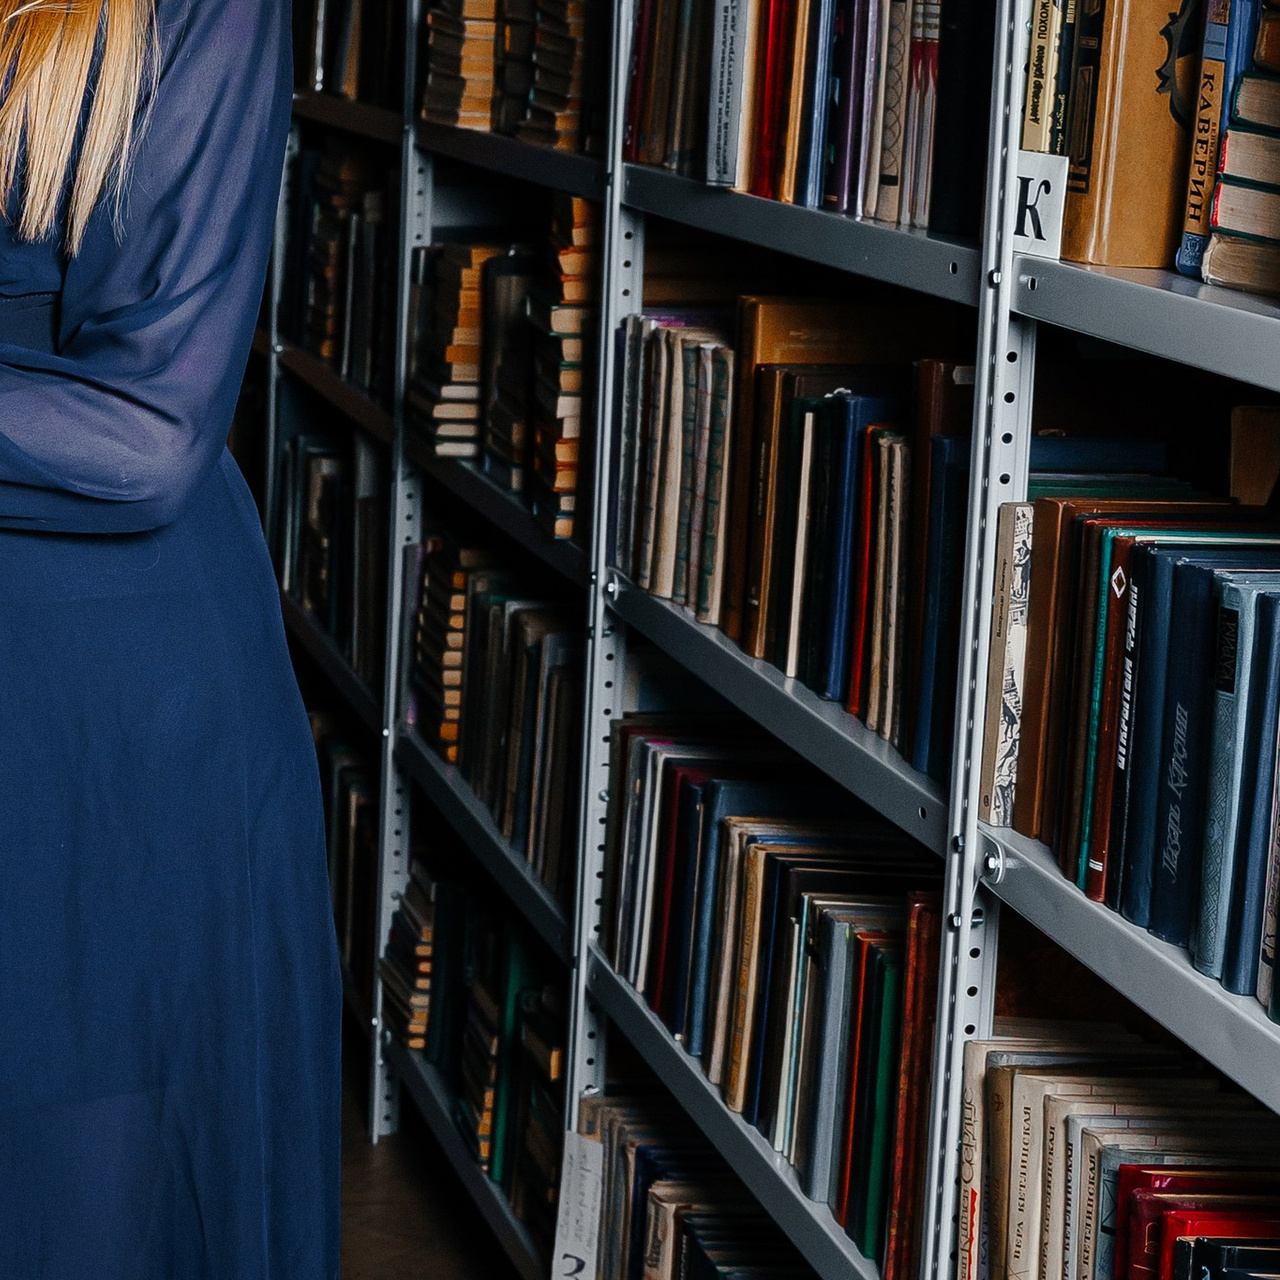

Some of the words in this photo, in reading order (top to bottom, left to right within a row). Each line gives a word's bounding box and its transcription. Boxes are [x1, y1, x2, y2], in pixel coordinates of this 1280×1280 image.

[1187, 71, 1214, 222] КАВЕРИН
[1015, 176, 1051, 242] К
[1221, 619, 1237, 681] КАРИМ
[1164, 701, 1190, 800] Карелин
[1160, 804, 1182, 883] Лазарь
[1016, 1105, 1032, 1213] КЕТЛИНСКАЯ
[1042, 1124, 1056, 1234] КЕТЛИНСКАЯ
[1063, 1141, 1075, 1252] КЕТЛИНСКАЯ
[1012, 1221, 1024, 1261] ВЕРА
[1081, 1153, 1096, 1265] КЕТЛИНСКАЯ
[1040, 1240, 1050, 1280] ВЕРА
